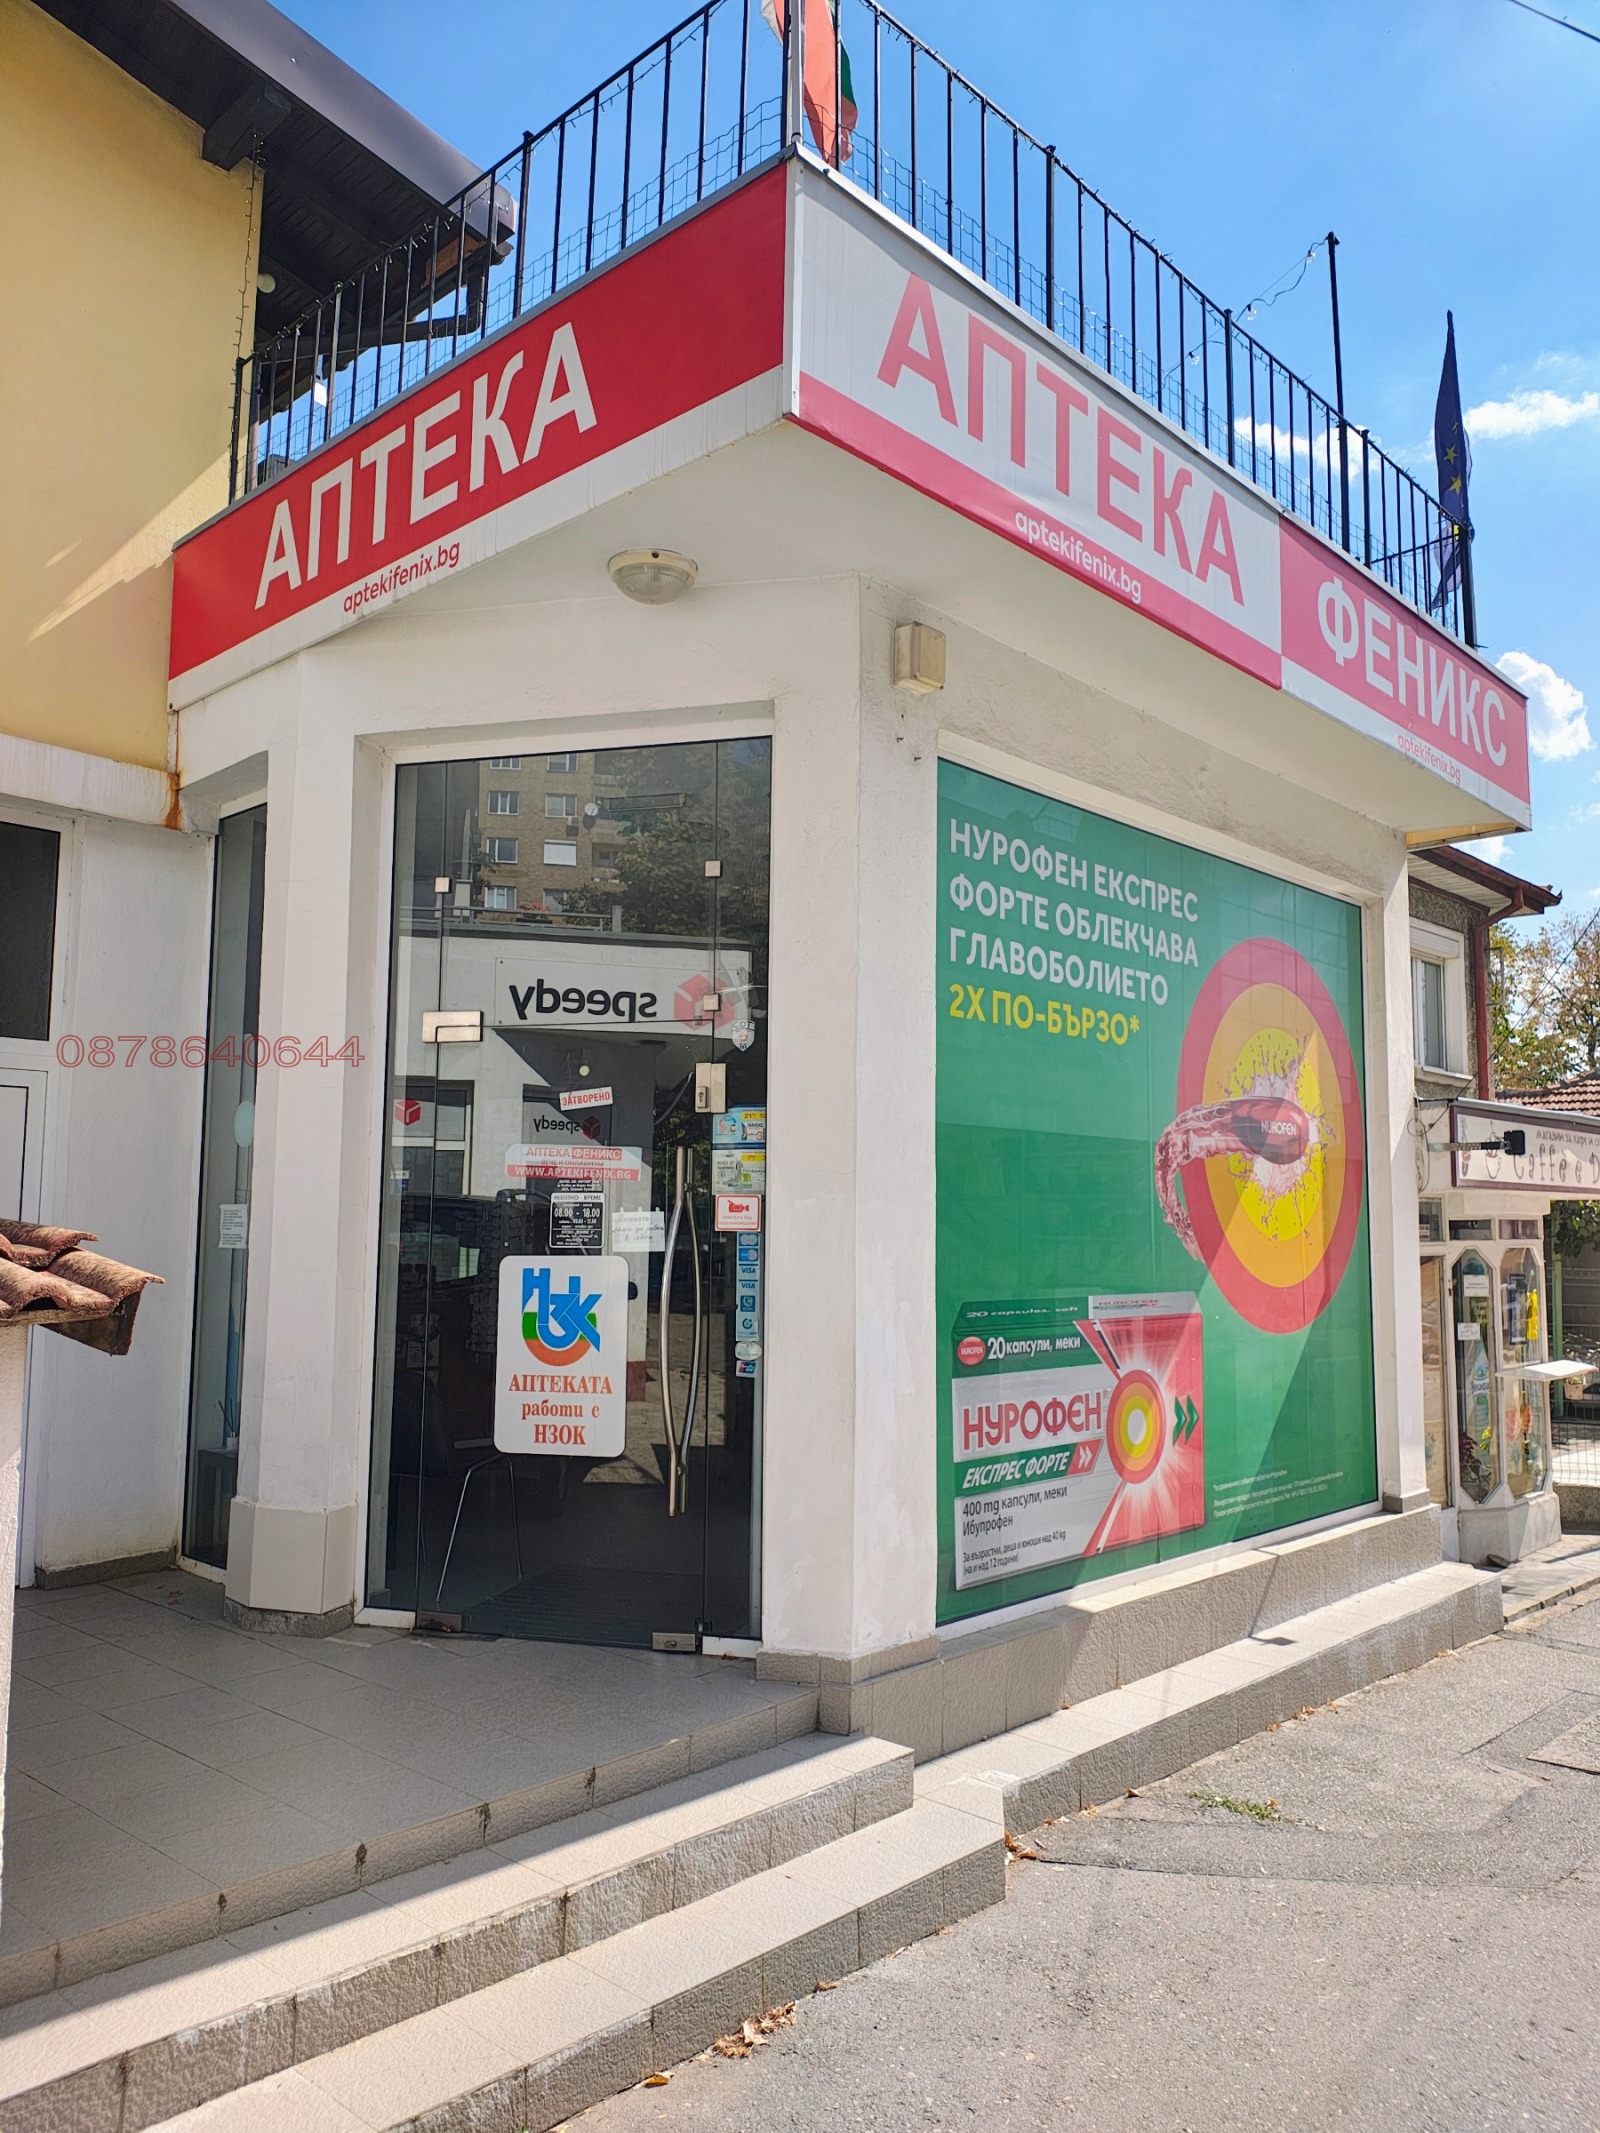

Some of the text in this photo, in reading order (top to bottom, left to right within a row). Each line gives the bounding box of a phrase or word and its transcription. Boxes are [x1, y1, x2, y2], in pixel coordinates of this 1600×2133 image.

[877, 271, 1245, 607] АПТЕКА
[254, 321, 598, 611] АПТЕКА
[1014, 510, 1142, 605] aptekifenix.bg
[343, 541, 461, 614] aptekifenix.bg
[1317, 576, 1508, 767] ФЕНИКС
[1397, 733, 1461, 786] aptekifenix.bg
[950, 818, 1199, 923] НУРОФЕН ЕКСПРЕС
[949, 873, 1199, 968] ФОРТЕ ОБЛЕКЧАВА
[949, 927, 1169, 1006] ГЛАВОБОЛИЕТО
[562, 1091, 611, 1107] ЗАТВОРЕНО
[1261, 1120, 1297, 1136] NUROFEN
[526, 1147, 621, 1160] АПТЕКА ФЕНИКС
[515, 1166, 631, 1180] WWW.APTEKIFENIX.BG
[554, 1207, 574, 1218] 08.00
[583, 1207, 601, 1218] 18.00
[987, 1336, 1080, 1360] 20 капсули, меки
[508, 1373, 613, 1395] АПТЕКАТА
[521, 1399, 600, 1420] работи с
[533, 1423, 586, 1446] НЗОК
[962, 1451, 1071, 1490] ЕКСПРЕС ФОРТЕ
[962, 1486, 1068, 1518] 400 mg капсули, меки
[963, 1513, 1014, 1538] Ибупрофен
